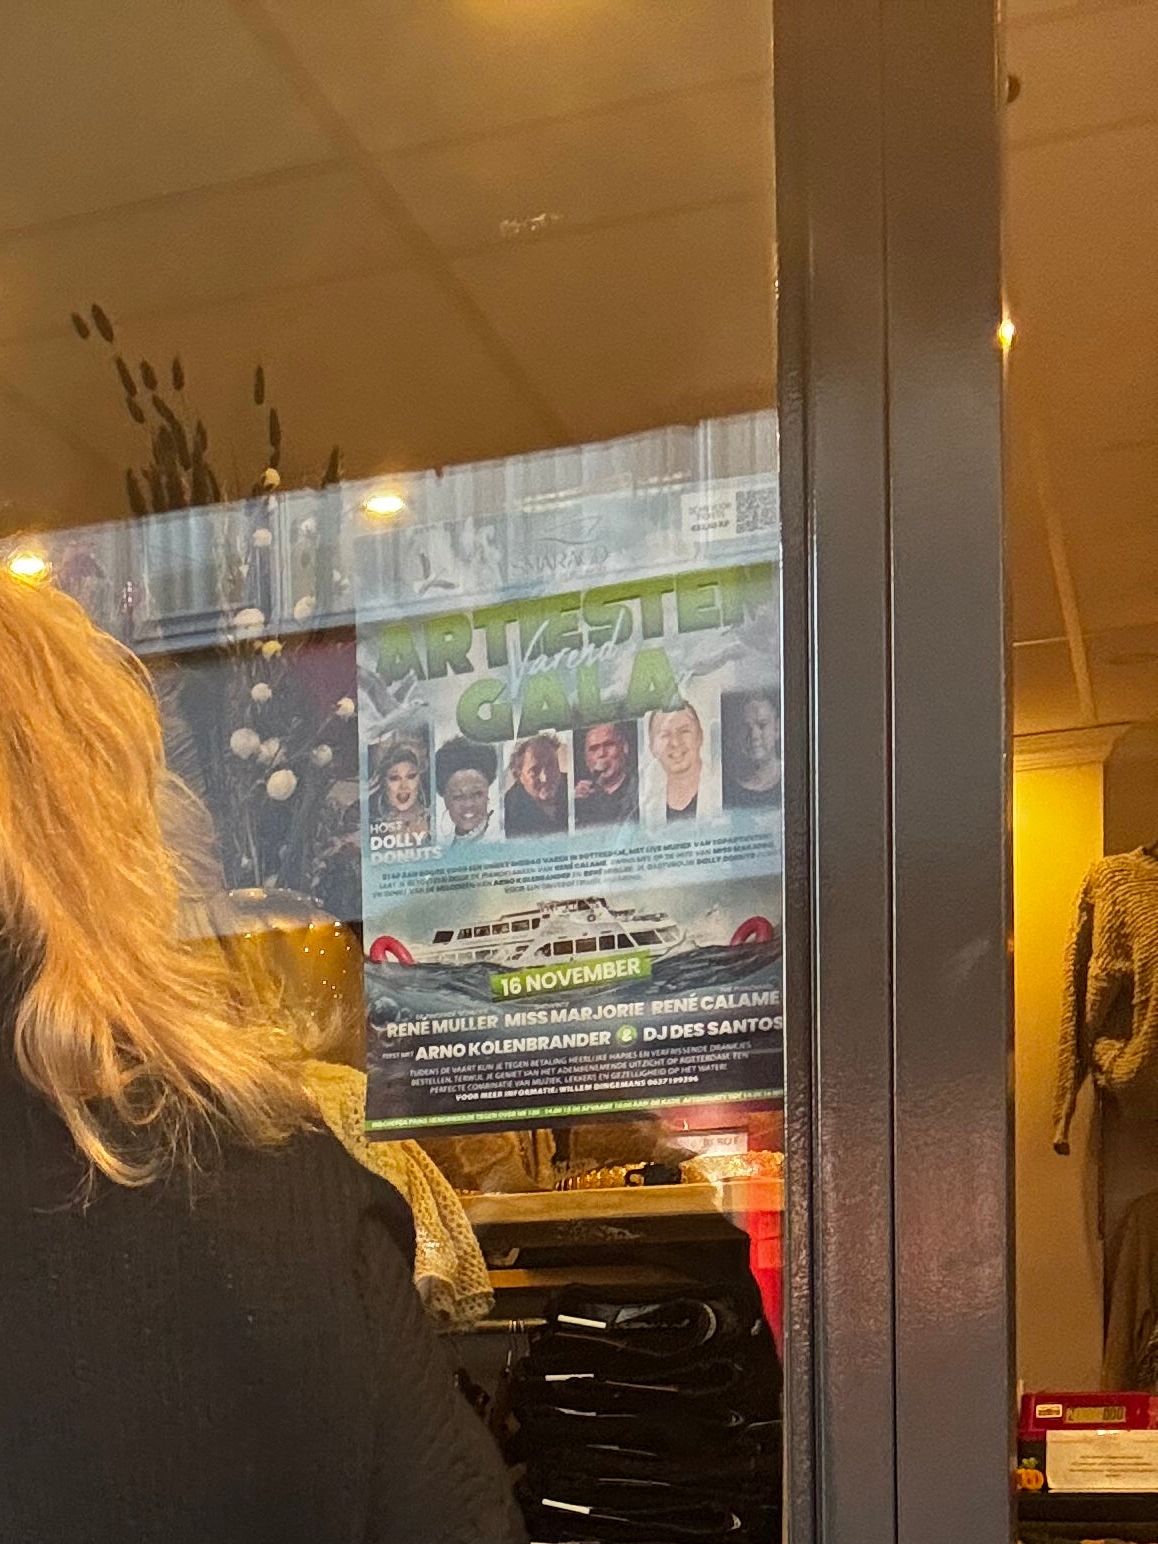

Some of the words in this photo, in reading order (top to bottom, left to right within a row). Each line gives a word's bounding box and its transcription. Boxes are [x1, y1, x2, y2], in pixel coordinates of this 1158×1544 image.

[457, 647, 690, 743] GALA
[370, 820, 403, 835] HOST
[370, 831, 425, 851] DOLLY
[370, 846, 442, 863] DONUTS
[500, 975, 522, 997] 16
[527, 957, 641, 992] NOVEMBER
[386, 1015, 430, 1039] RENÉ
[432, 1014, 499, 1035] MULLER
[504, 1010, 548, 1028] MISS
[550, 1001, 645, 1024] MARJORIE
[651, 993, 698, 1015] RENÉ
[700, 990, 780, 1011] CALAME
[415, 1044, 466, 1062] ARNO
[468, 1030, 611, 1058] KOLENBRANDER
[621, 1028, 633, 1043] &
[643, 1027, 668, 1042] DJ
[670, 1023, 706, 1039] DES
[707, 1015, 784, 1037] SANTOS
[504, 1059, 528, 1069] TEGEN
